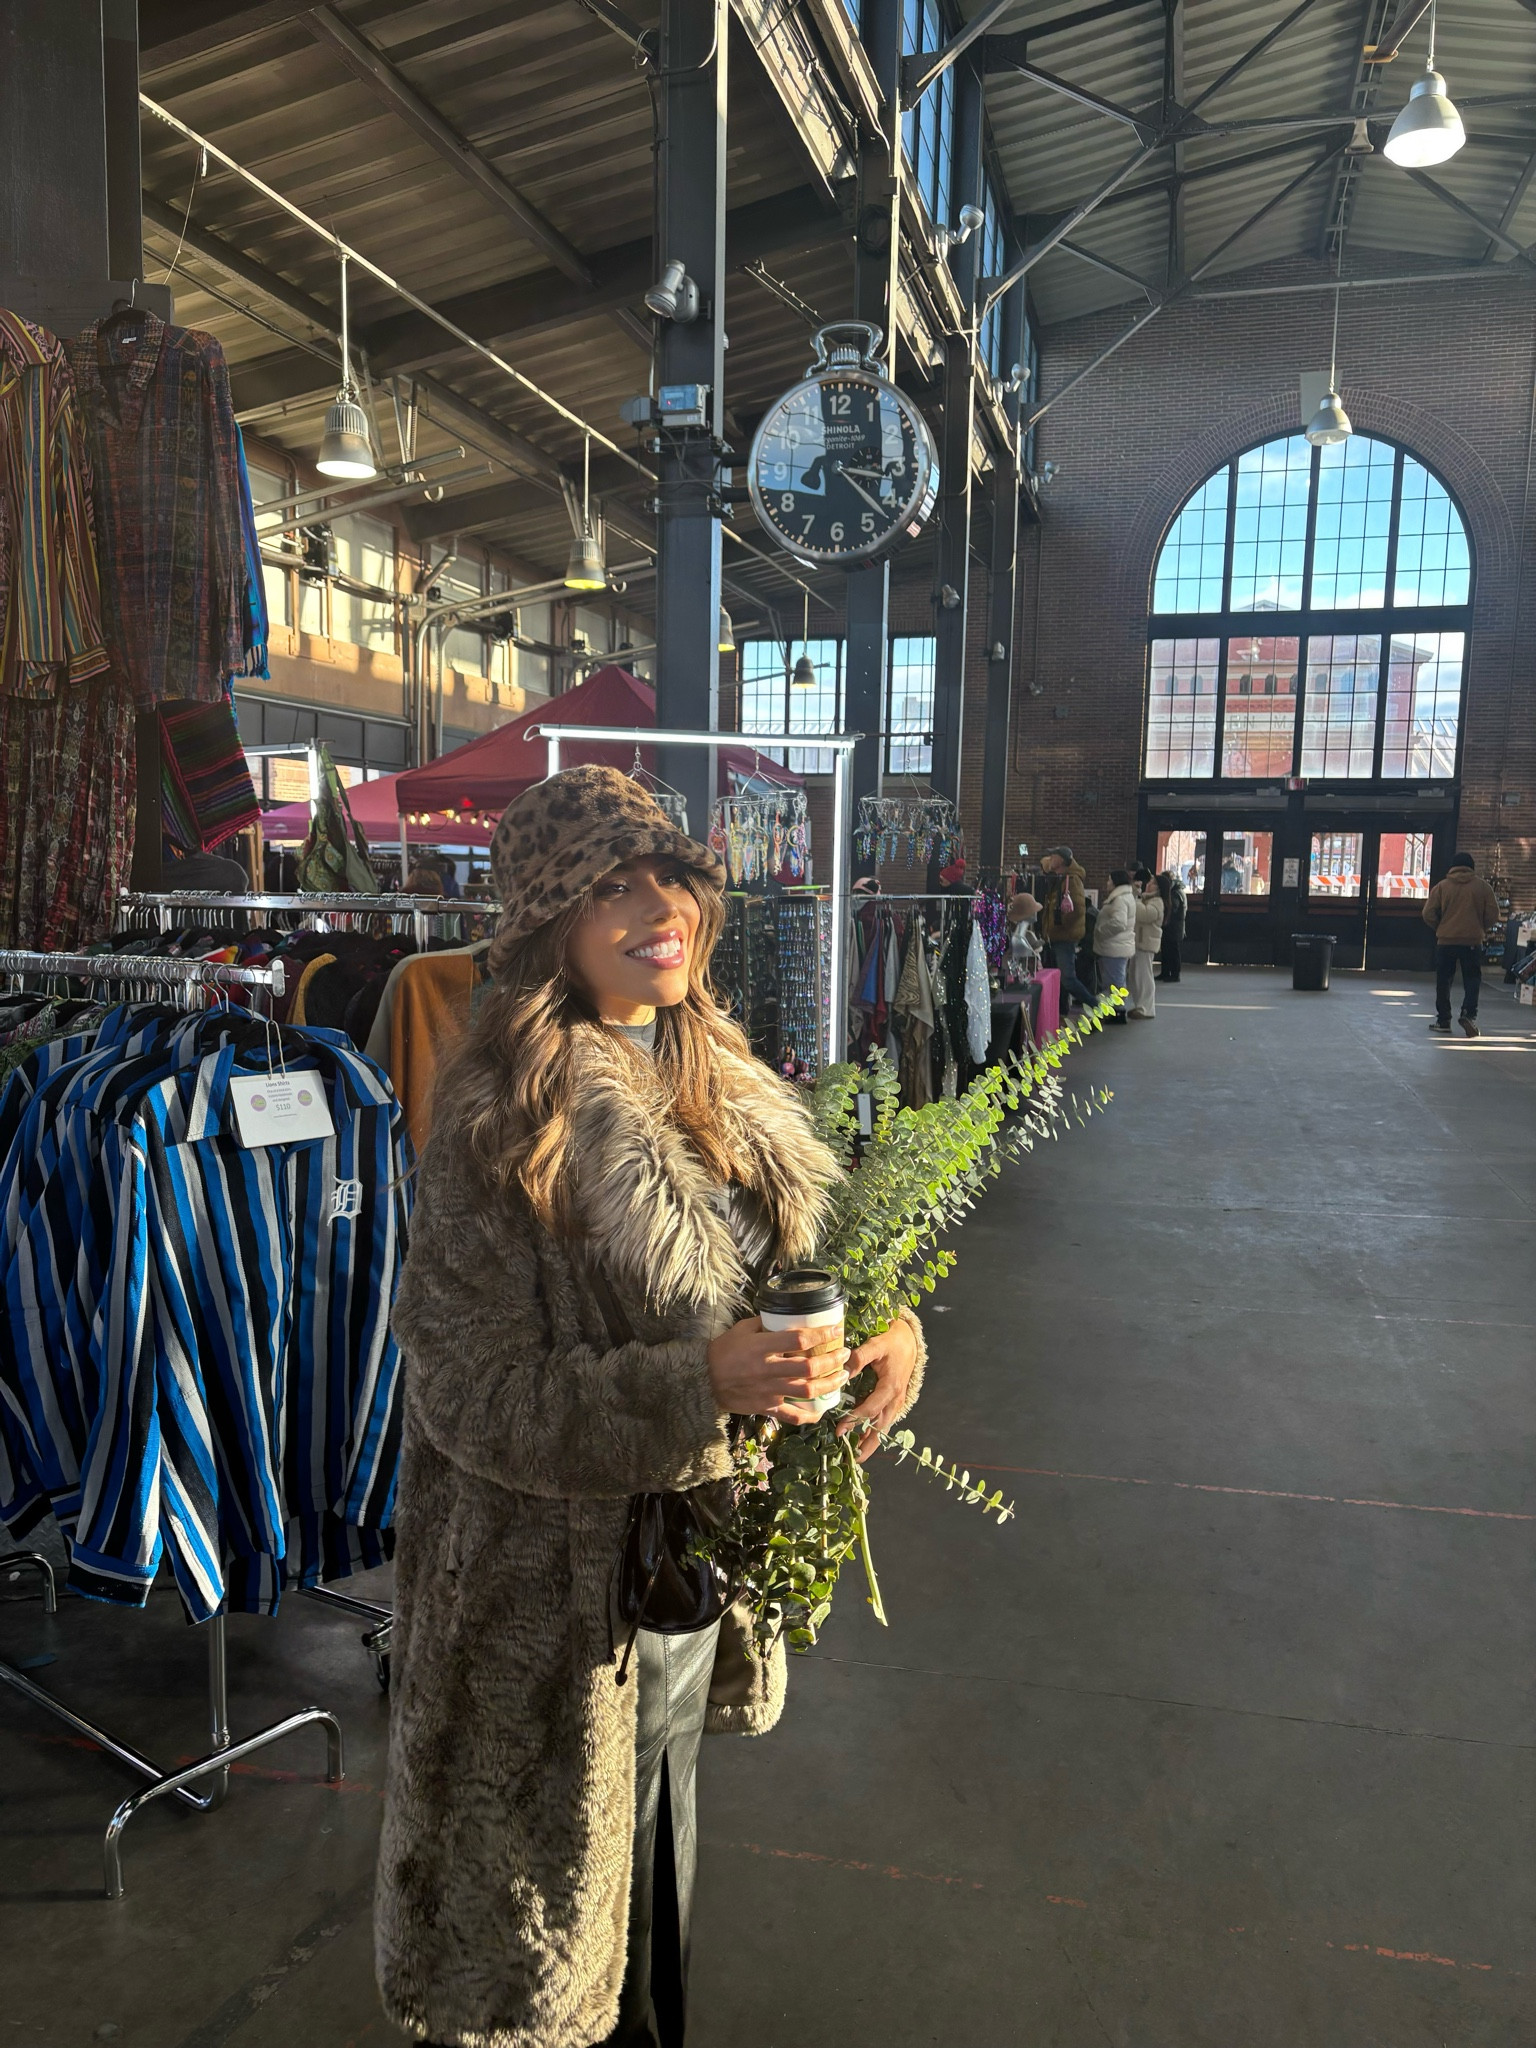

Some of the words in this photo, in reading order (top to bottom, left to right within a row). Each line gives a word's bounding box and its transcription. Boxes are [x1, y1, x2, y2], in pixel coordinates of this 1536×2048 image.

[803, 405, 819, 425] 11
[829, 395, 851, 415] 12
[866, 402, 874, 422] 1
[780, 429, 800, 450] 10
[821, 424, 860, 435] SHINOLA
[884, 424, 899, 445] 2
[826, 442, 855, 450] DETROIT
[773, 461, 787, 481] 9
[892, 456, 906, 477] 3
[780, 492, 795, 513] 8
[882, 488, 897, 508] 4
[802, 514, 815, 535] 7
[830, 521, 844, 542] 6
[860, 512, 875, 532] 5
[275, 1103, 291, 1111] $110
[327, 1175, 363, 1226] D
